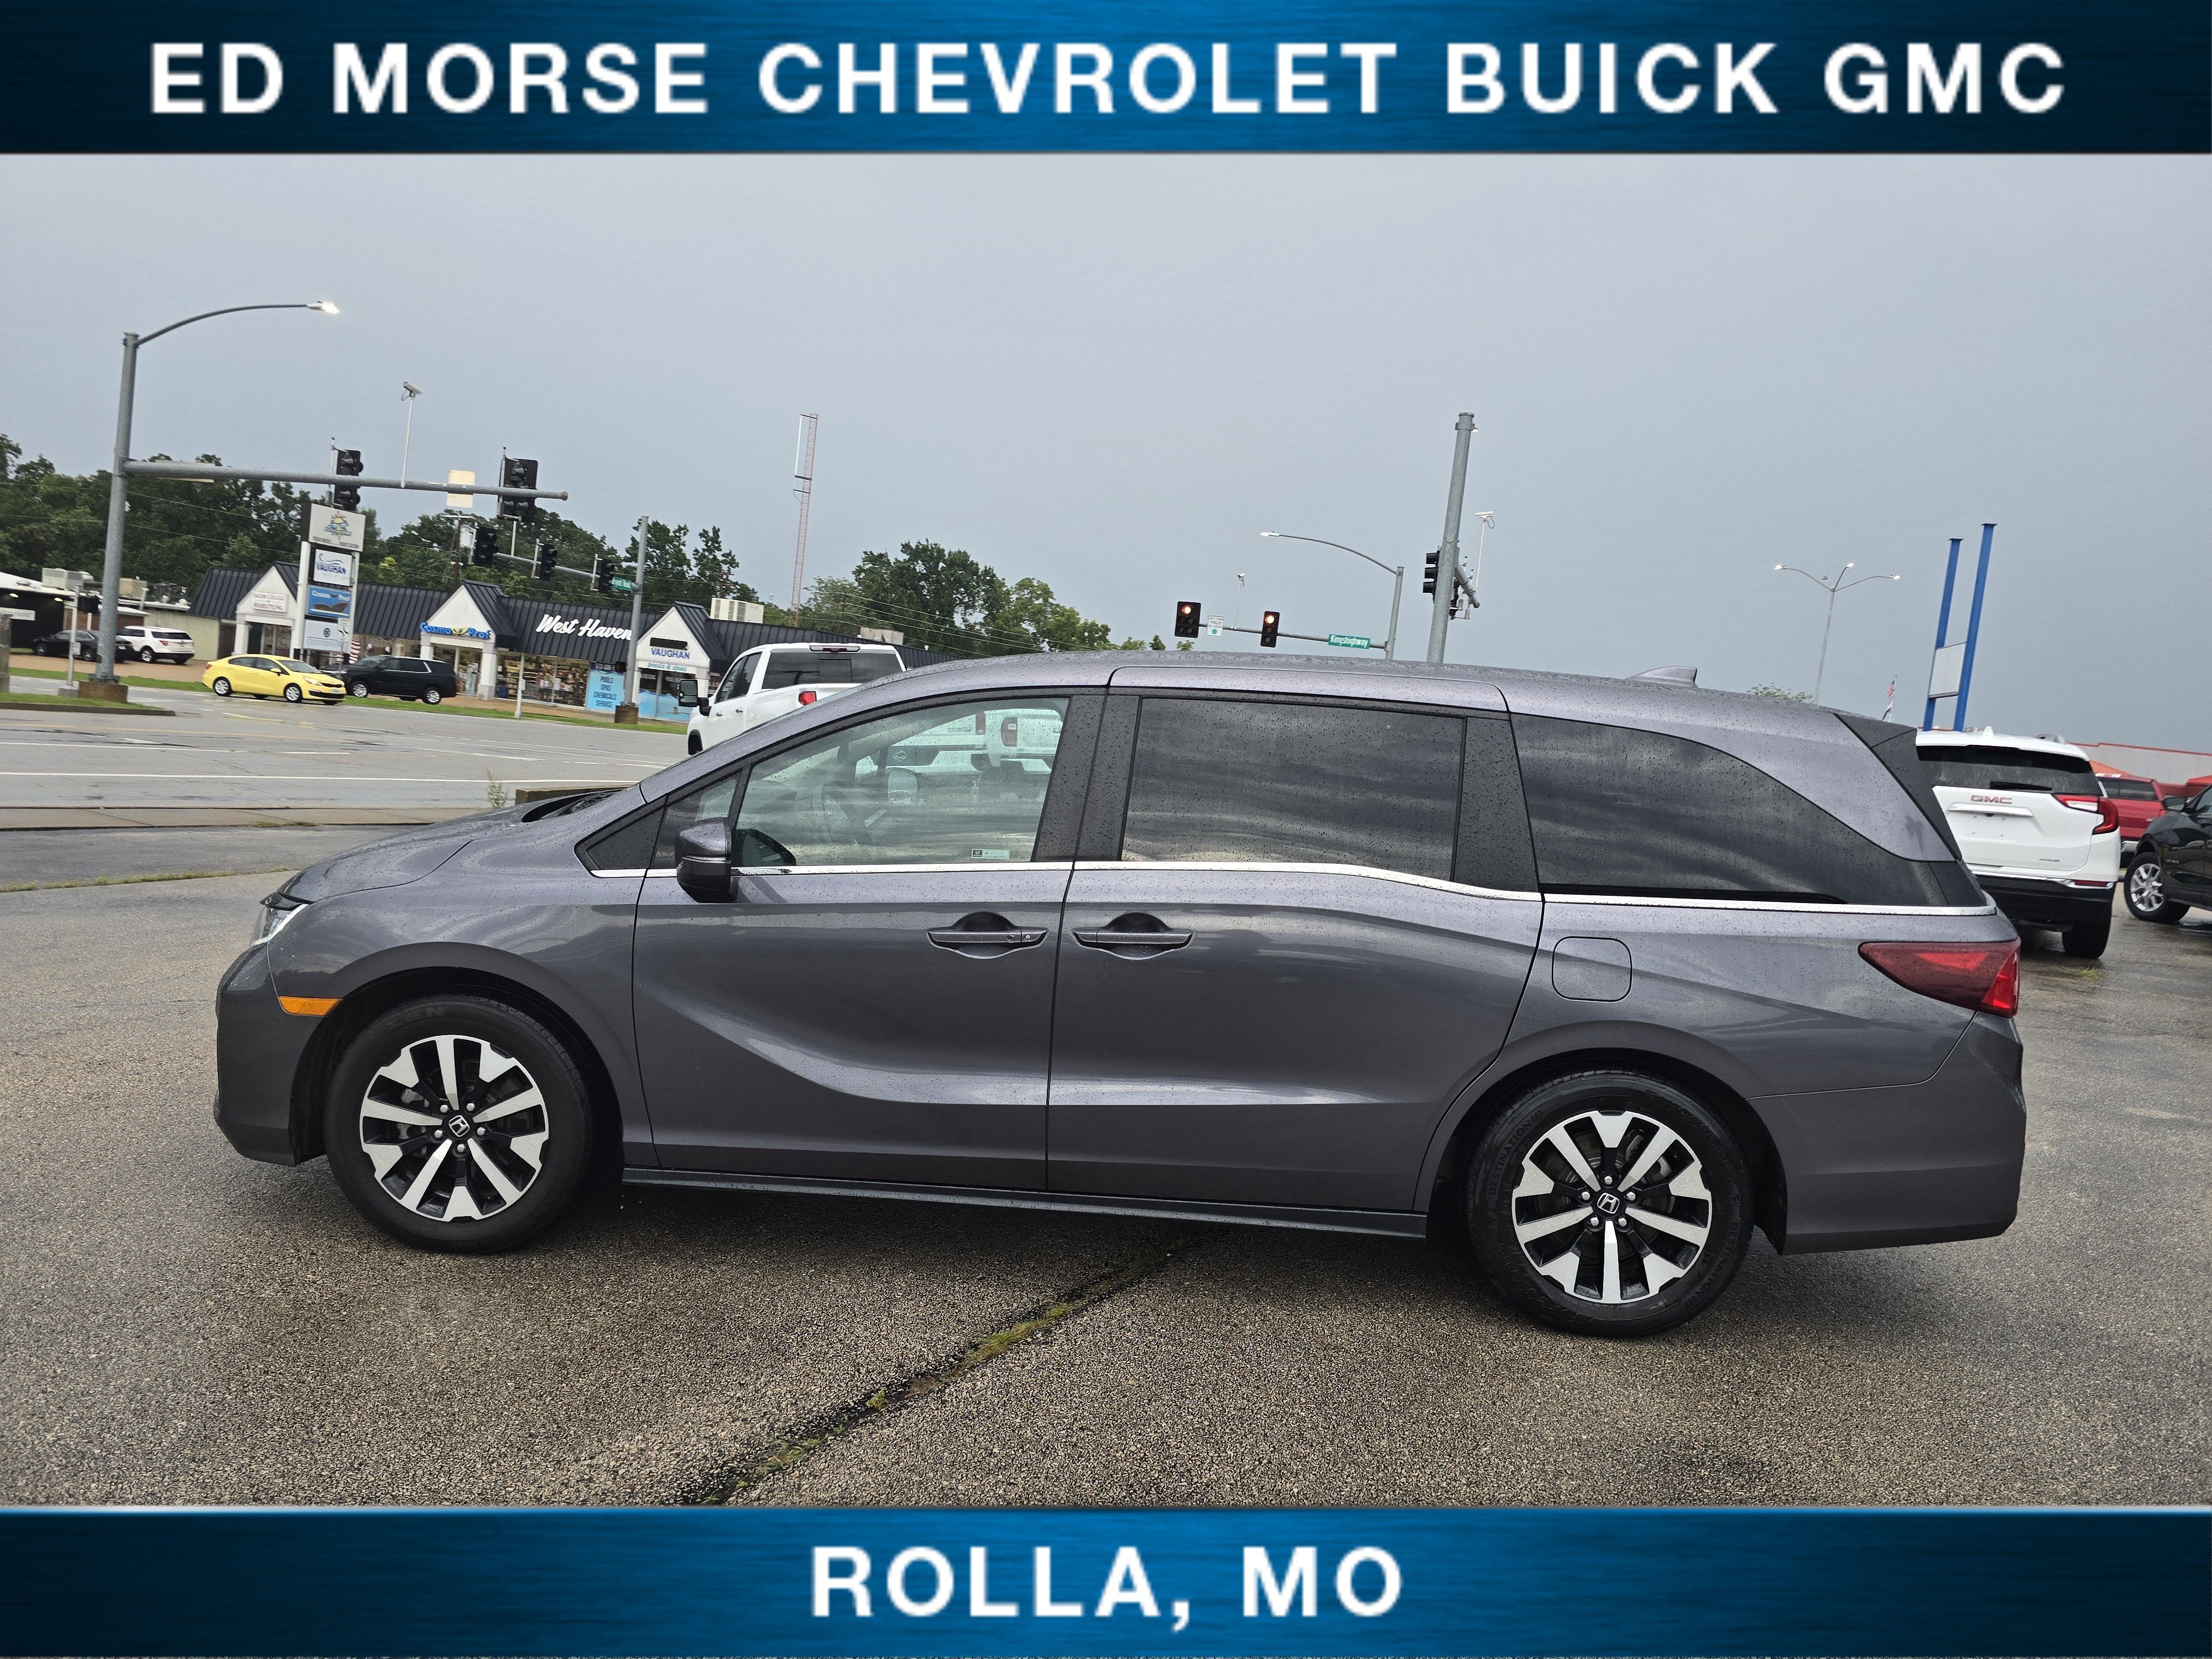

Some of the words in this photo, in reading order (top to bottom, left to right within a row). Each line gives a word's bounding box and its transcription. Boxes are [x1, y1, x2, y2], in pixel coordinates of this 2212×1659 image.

[419, 621, 452, 635] Cosmo
[468, 627, 492, 640] Prof
[535, 614, 580, 635] West
[578, 618, 633, 641] Haven
[650, 648, 690, 660] VAUGHAN
[1971, 795, 2012, 804] GMC
[1489, 1119, 1532, 1196] DESTINATION
